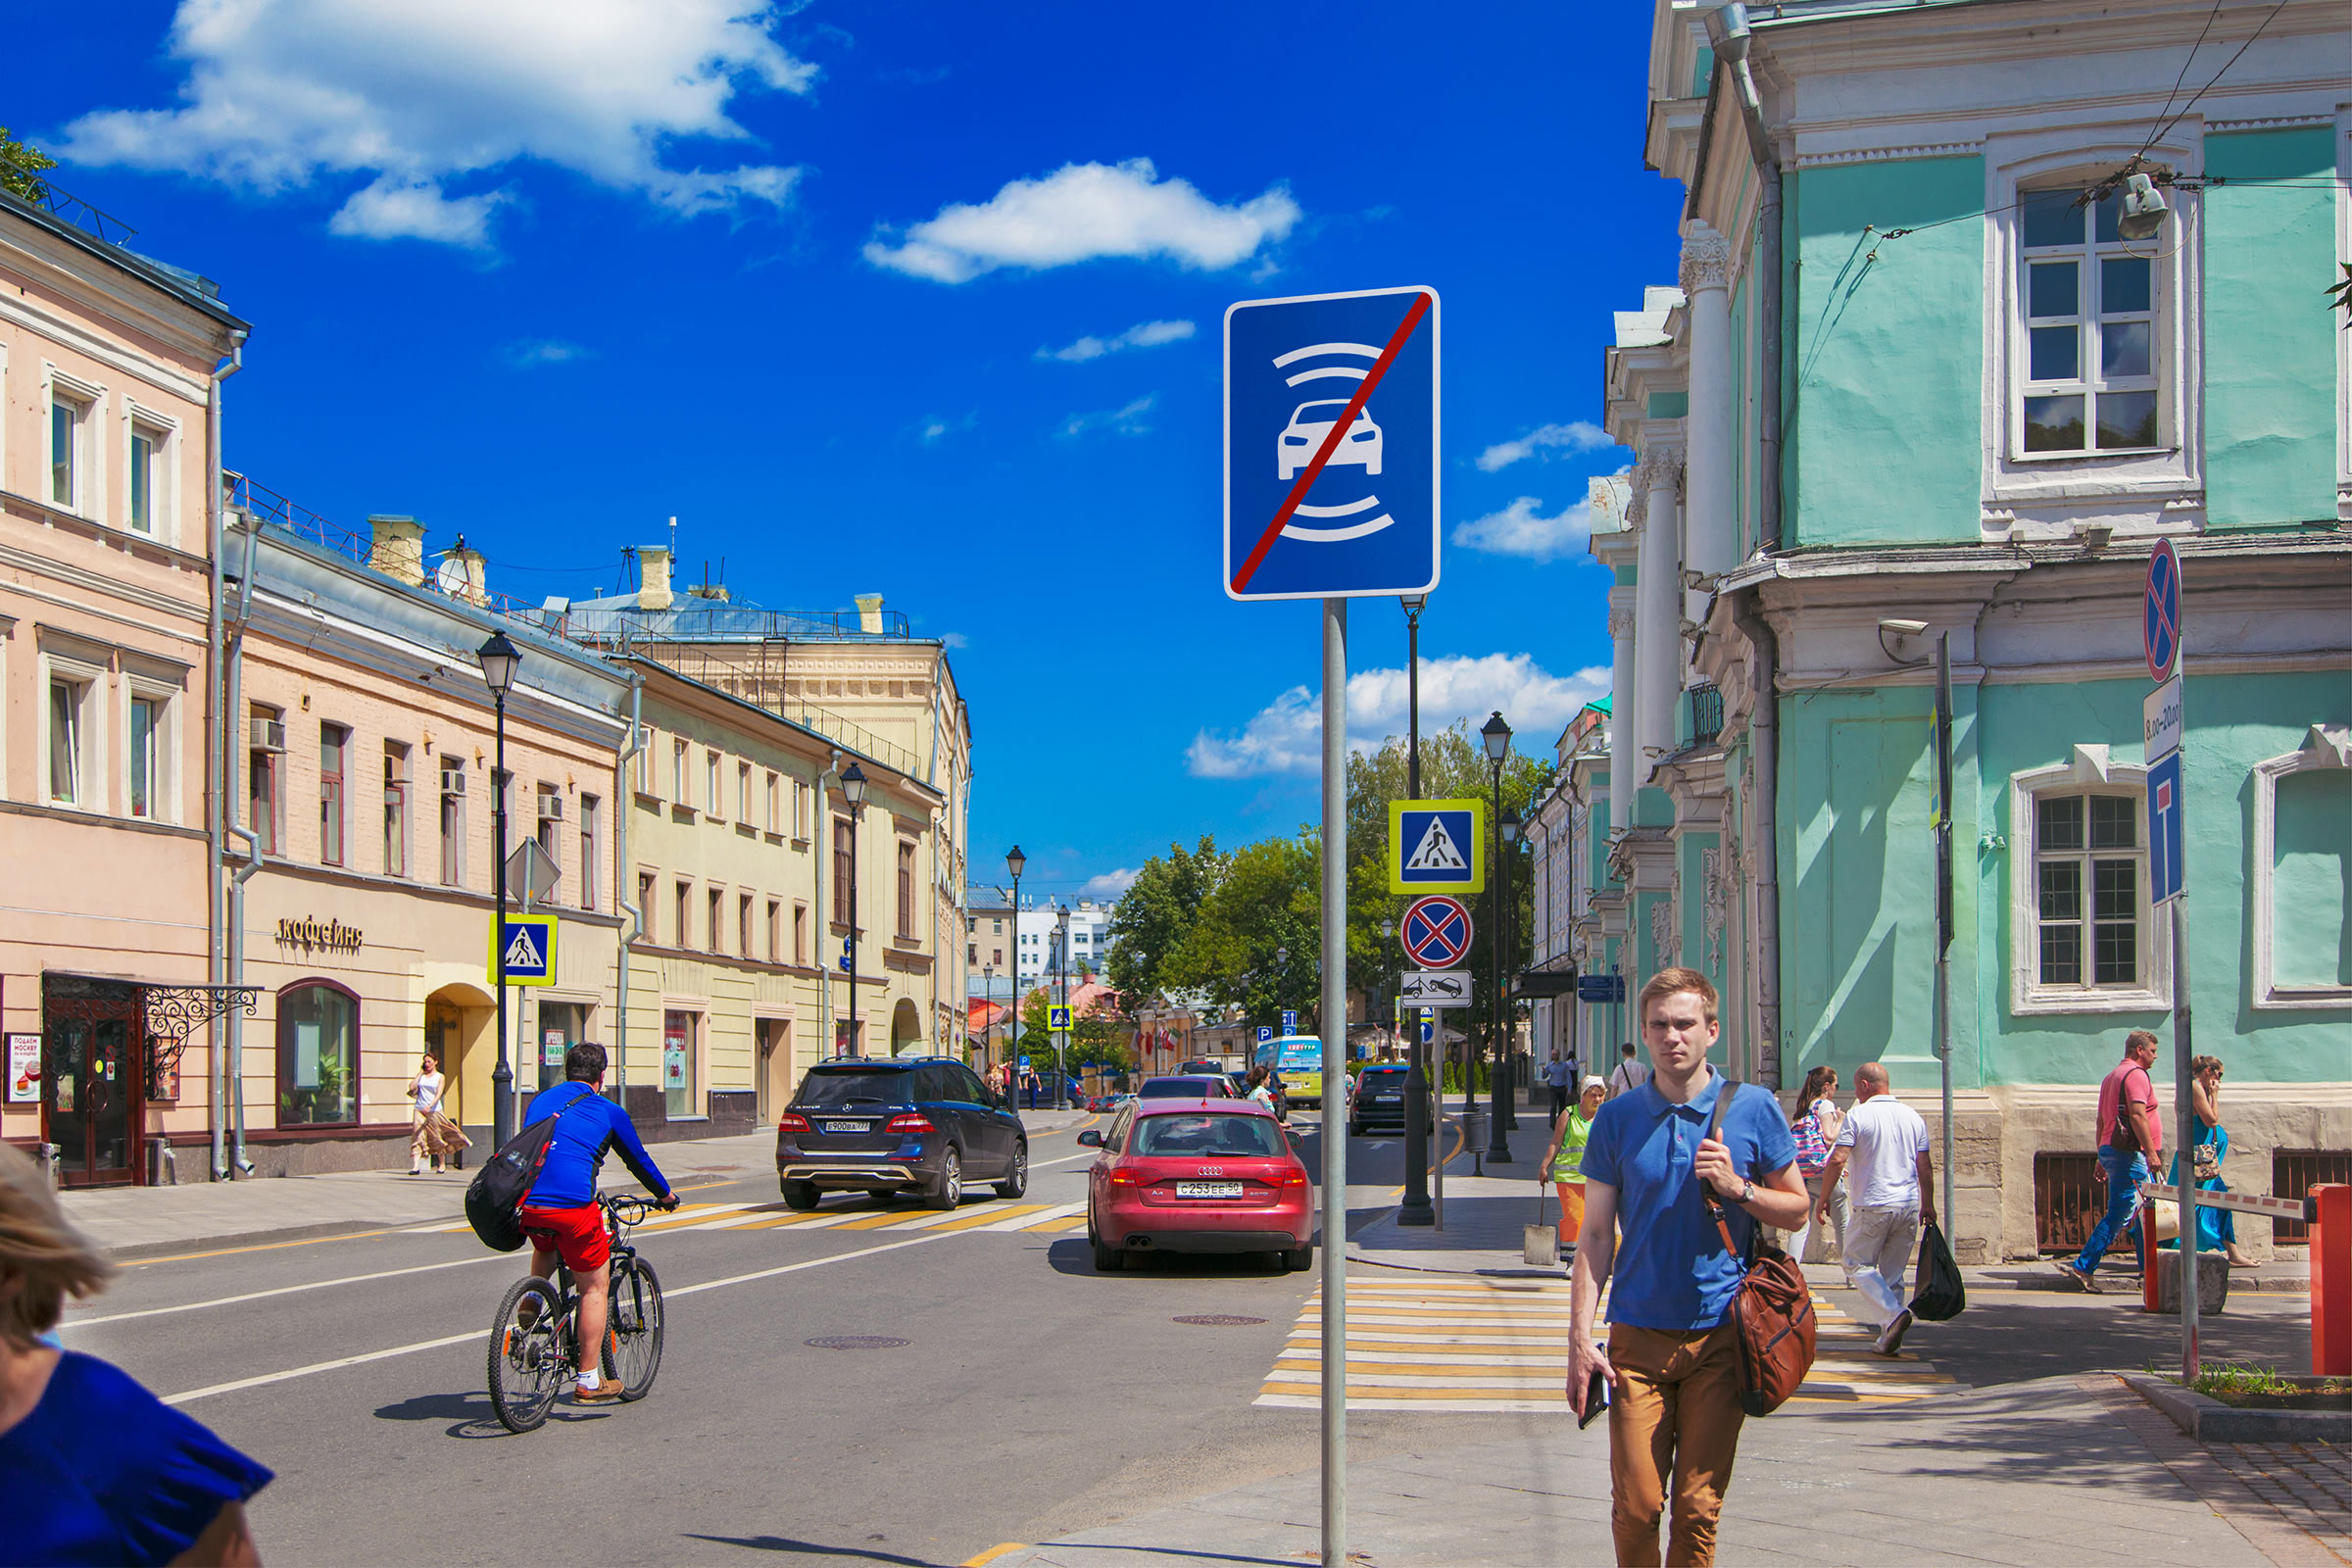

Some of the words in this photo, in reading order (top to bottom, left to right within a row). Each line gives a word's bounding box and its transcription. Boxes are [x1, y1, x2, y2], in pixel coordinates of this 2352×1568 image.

[2146, 704, 2179, 741] 8.00-20.00
[278, 914, 363, 949] кофейня
[1260, 1030, 1269, 1040] P
